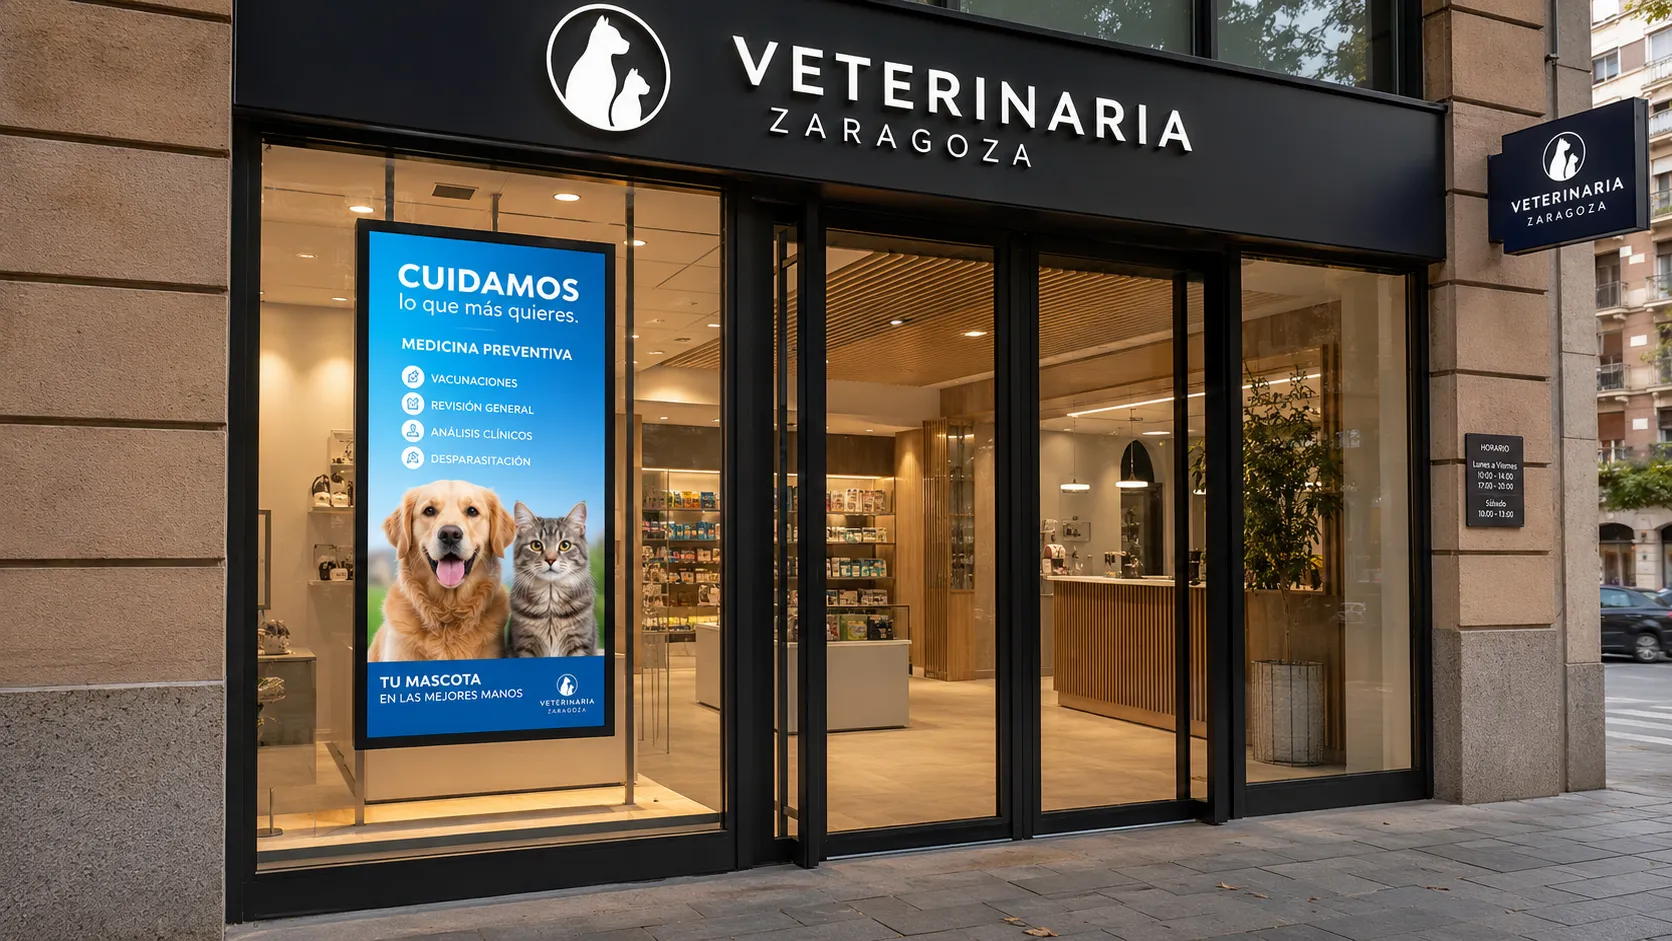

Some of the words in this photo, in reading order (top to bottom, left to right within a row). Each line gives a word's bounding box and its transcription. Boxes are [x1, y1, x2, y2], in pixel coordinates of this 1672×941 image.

[732, 35, 1193, 152] VETERINARIA
[769, 107, 1032, 168] ZARAGOZA
[1511, 176, 1624, 213] VETERINARIA
[1527, 201, 1606, 227] ZARAGOZA
[398, 263, 580, 302] CUIDAMOS
[399, 292, 417, 311] lo
[422, 298, 459, 316] que
[465, 300, 503, 317] más
[508, 304, 579, 323] quieres.
[401, 337, 479, 354] MEDICINA
[483, 343, 573, 360] PREVENTIVA
[431, 373, 518, 388] VACUNACIONES
[431, 400, 482, 412] REVISIÓN
[485, 403, 534, 415] GENERAL
[431, 426, 480, 439] ANÁLISIS
[483, 428, 533, 441] CLÍNICOS
[1480, 444, 1510, 453] HORARIO
[431, 454, 531, 467] DESPARASITACIÓN
[1472, 460, 1490, 469] Lunes
[380, 676, 400, 688] TU
[405, 673, 481, 688] MASCOTA
[380, 694, 396, 704] EN
[400, 692, 421, 703] LAS
[424, 690, 478, 702] MEJORES
[481, 688, 523, 699] MANOS
[540, 698, 595, 707] VETERINARIA
